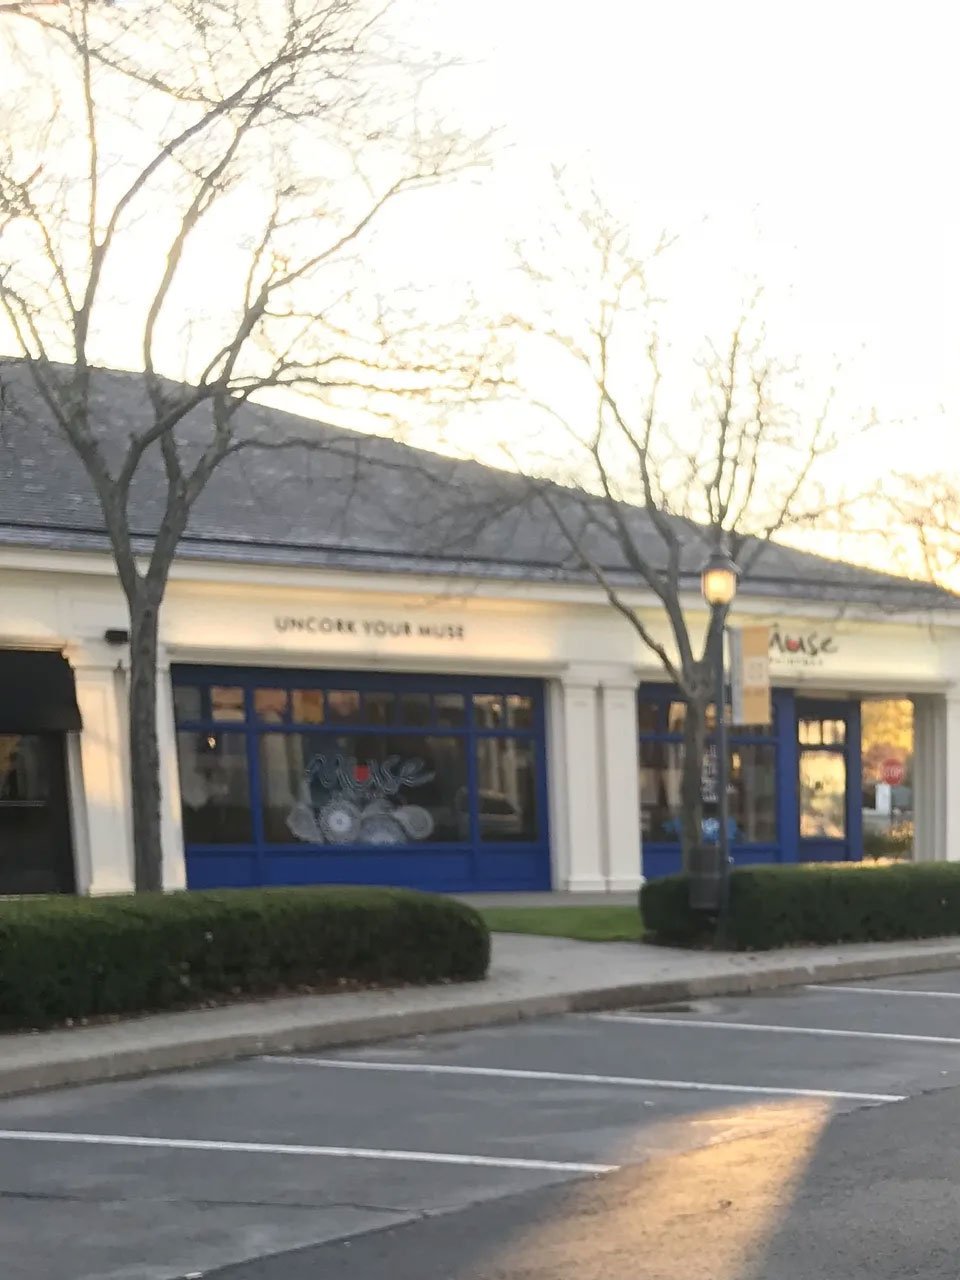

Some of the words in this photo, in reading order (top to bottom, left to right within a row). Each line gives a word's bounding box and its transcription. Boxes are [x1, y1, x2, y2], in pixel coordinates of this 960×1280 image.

[274, 616, 356, 635] UNCORK
[362, 619, 411, 639] YOUR
[419, 623, 464, 641] MUSE
